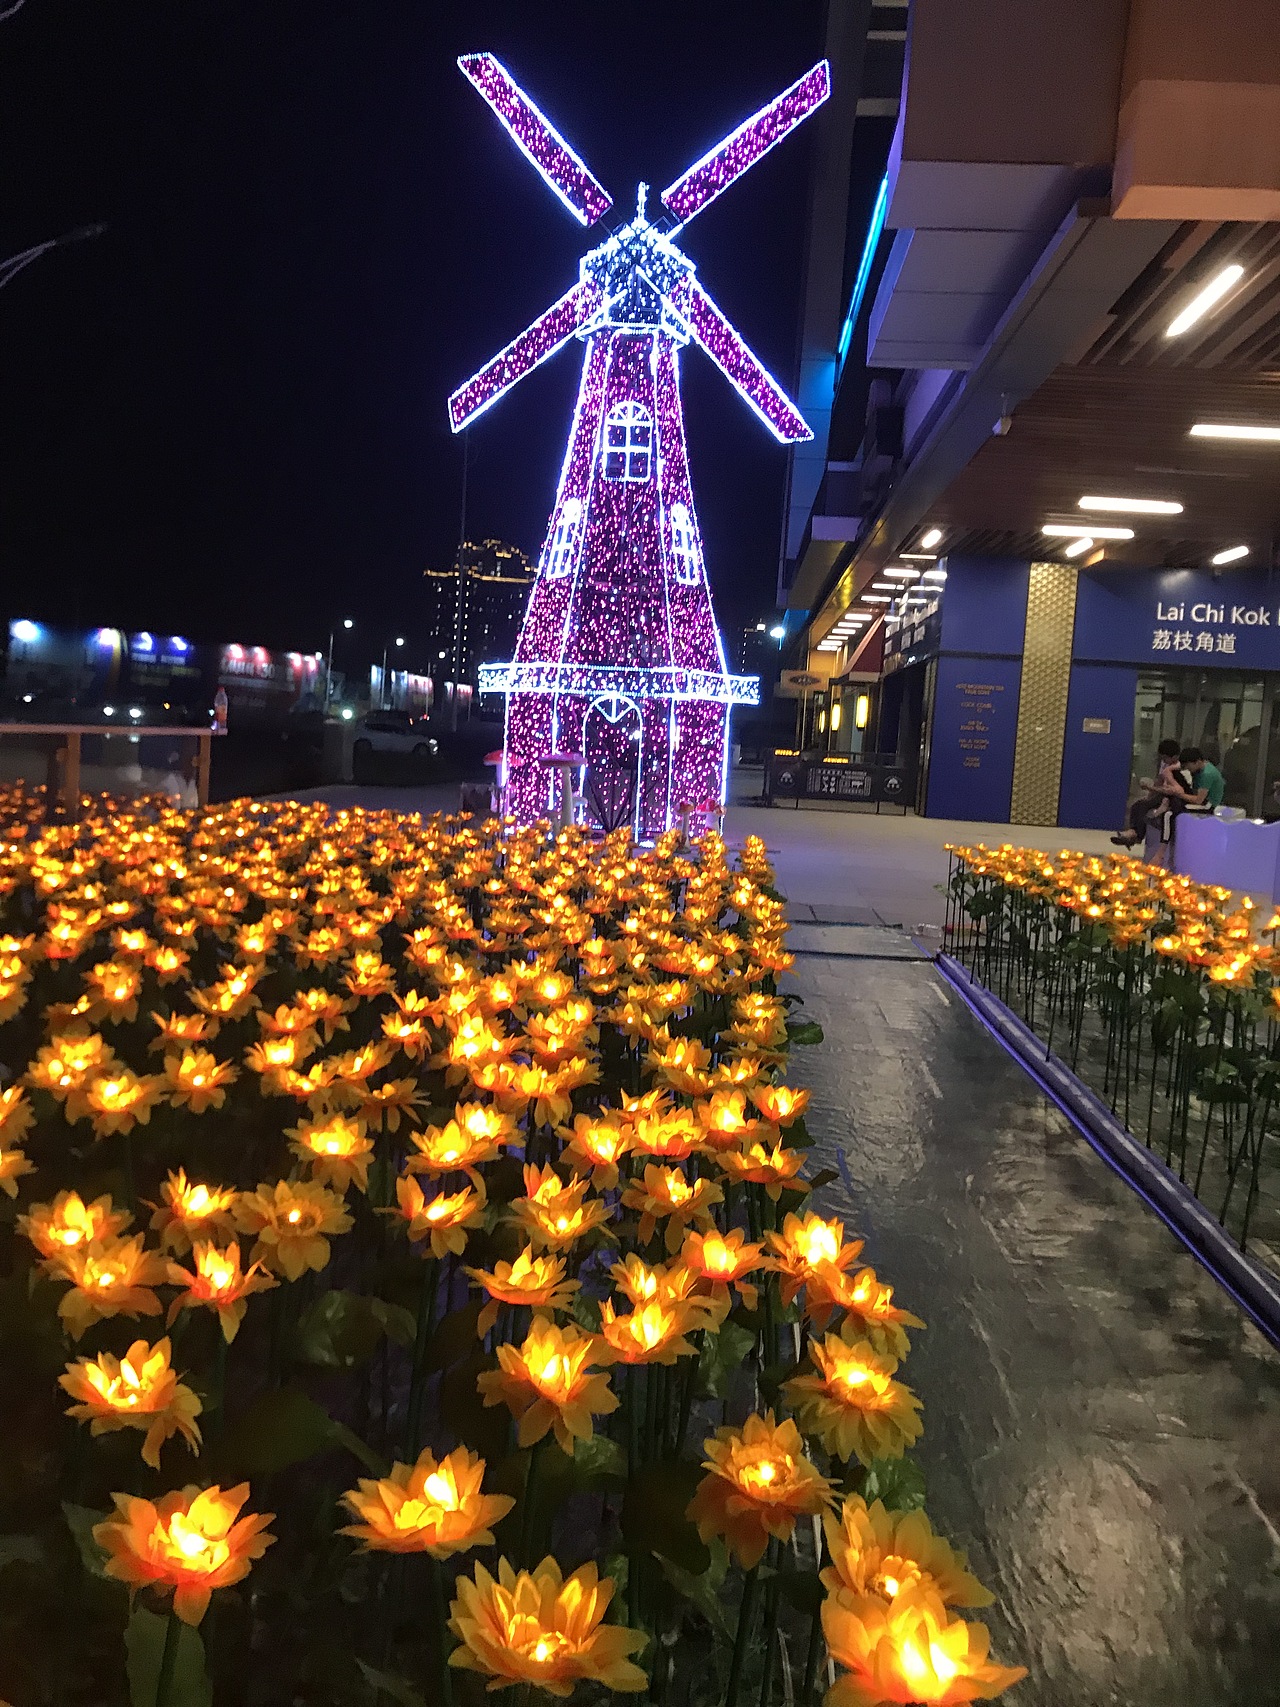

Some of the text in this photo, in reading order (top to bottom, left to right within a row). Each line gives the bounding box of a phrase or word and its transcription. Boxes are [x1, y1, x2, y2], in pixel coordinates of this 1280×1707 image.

[1157, 602, 1185, 621] Lai
[1191, 603, 1225, 623] Chi
[1231, 606, 1271, 626] Kok
[1152, 629, 1237, 654] 荔枝角道
